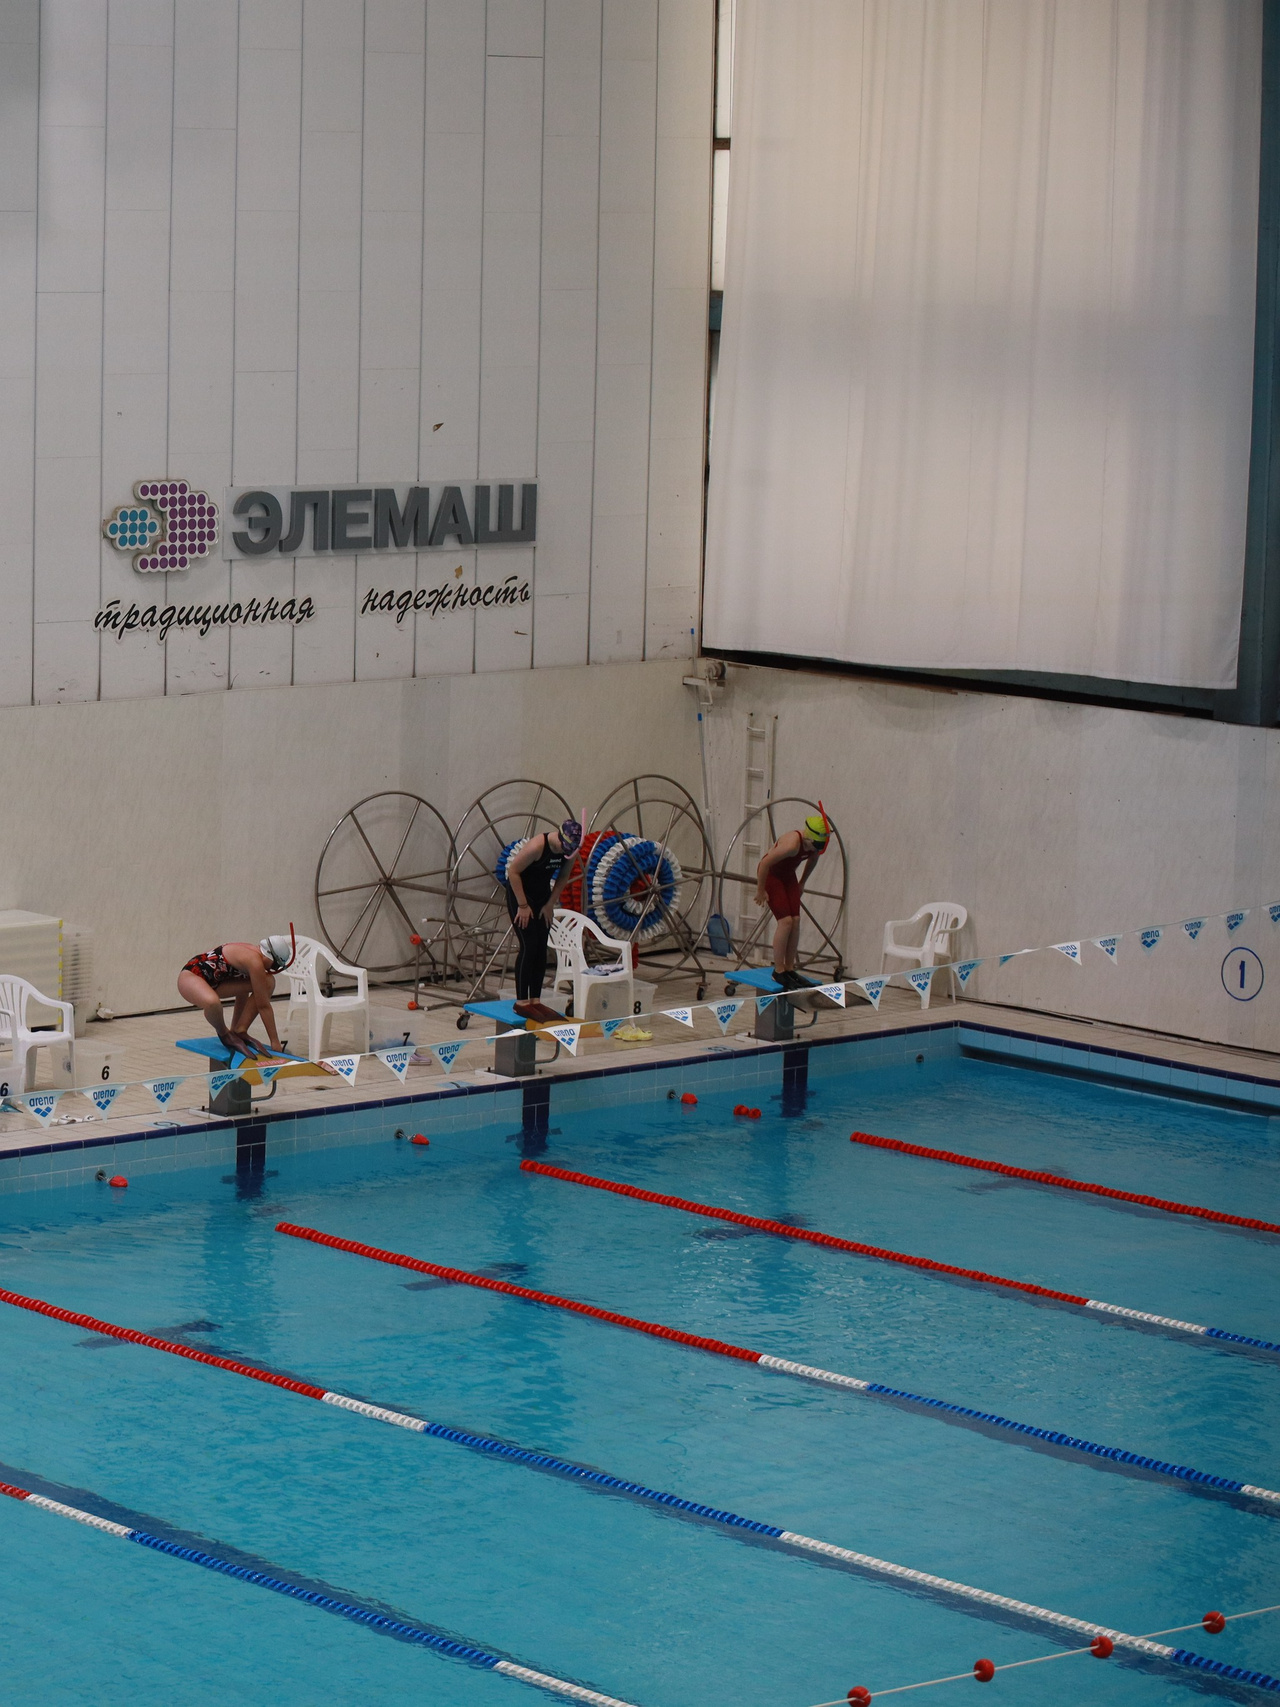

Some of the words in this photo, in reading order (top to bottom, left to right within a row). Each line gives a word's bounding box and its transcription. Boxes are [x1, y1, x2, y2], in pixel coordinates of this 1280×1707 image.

[232, 483, 537, 554] ЭЛЕМАШ
[94, 595, 317, 641] традиционная
[361, 575, 532, 623] надежность
[1226, 913, 1244, 923] arena
[1184, 921, 1202, 931] arena
[1141, 929, 1160, 940] arena
[1099, 938, 1116, 948] arena
[911, 971, 930, 982] arena
[1239, 960, 1246, 989] 1
[865, 980, 883, 990] arena
[633, 1000, 642, 1015] 8
[717, 1004, 736, 1015] arena
[553, 1028, 576, 1038] arena
[403, 1032, 411, 1047] 7
[438, 1044, 460, 1056] arena
[331, 1058, 355, 1068] arena
[386, 1052, 408, 1063] arena
[101, 1065, 110, 1081] 6
[211, 1074, 235, 1085] arena
[0, 1082, 9, 1098] 6
[153, 1082, 175, 1093] arena
[93, 1089, 116, 1100] arena
[29, 1095, 54, 1107] arena
